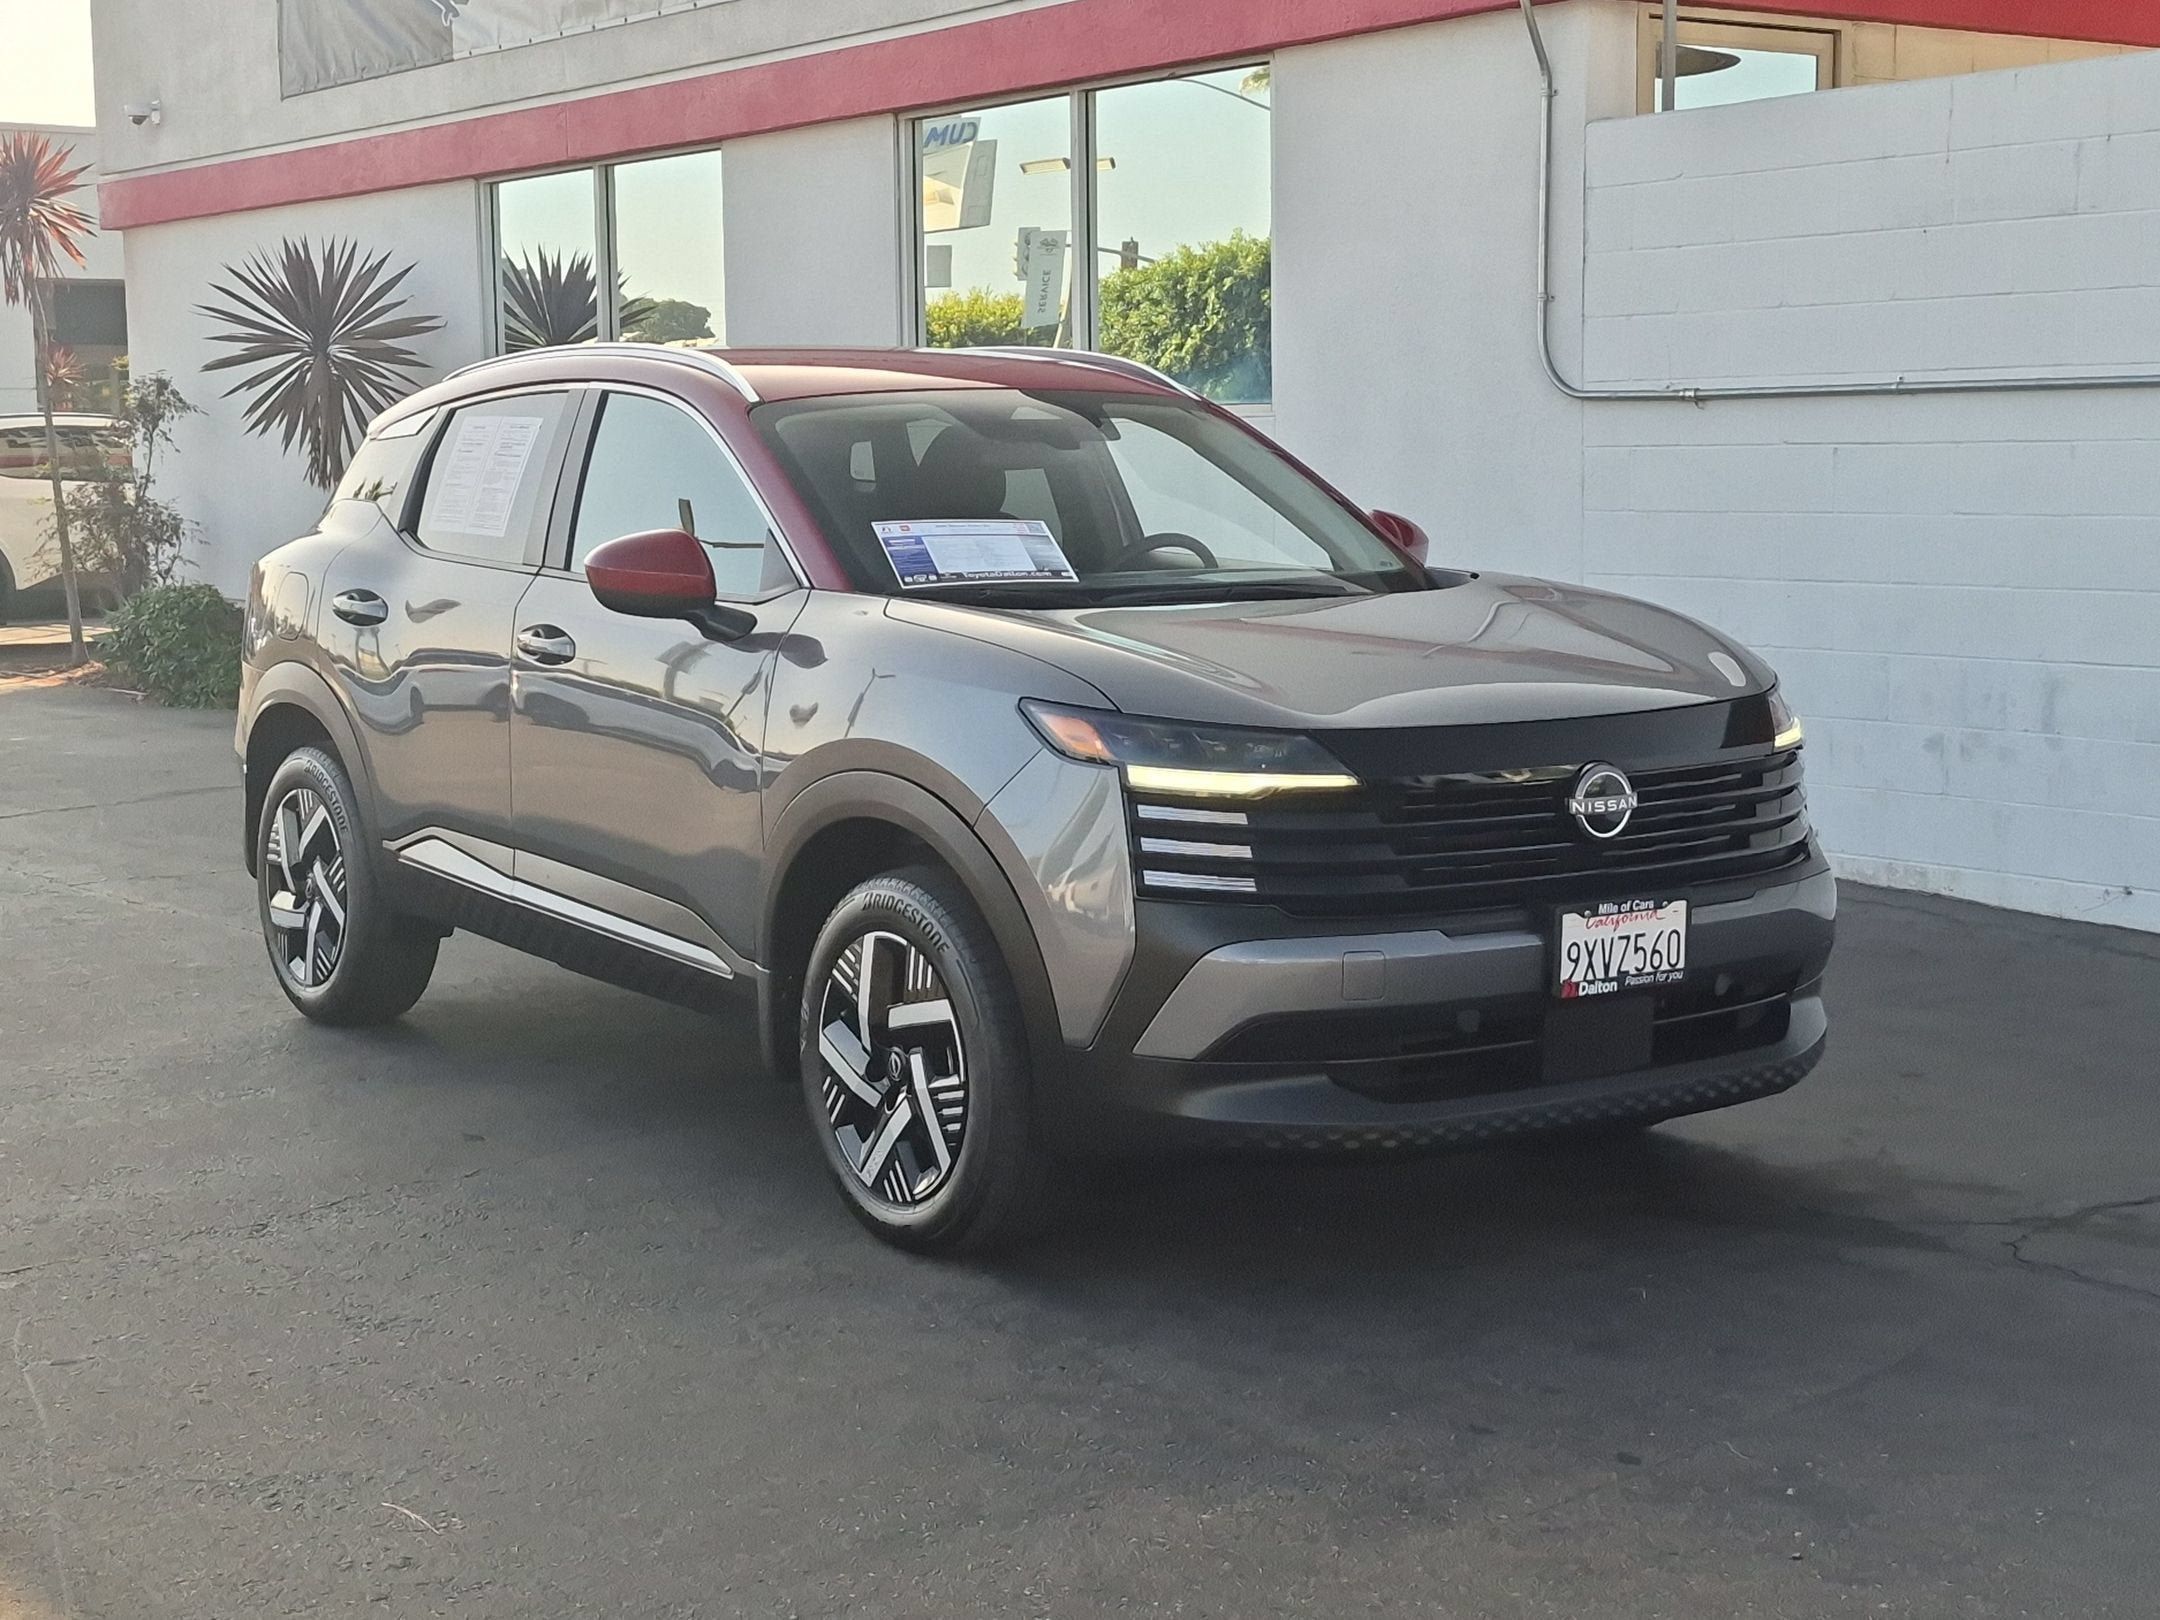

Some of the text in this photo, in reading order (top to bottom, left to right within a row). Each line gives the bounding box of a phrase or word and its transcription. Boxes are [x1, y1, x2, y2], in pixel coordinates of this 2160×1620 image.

[304, 759, 349, 833] BRIDGESTONE
[1571, 795, 1638, 813] NISSAN
[1598, 900, 1655, 915] Mile of Cars
[862, 892, 950, 953] BRIDGESTONE
[1585, 910, 1667, 932] California
[1655, 972, 1669, 982] for
[1667, 971, 1684, 982] you
[1578, 981, 1618, 997] Dalton
